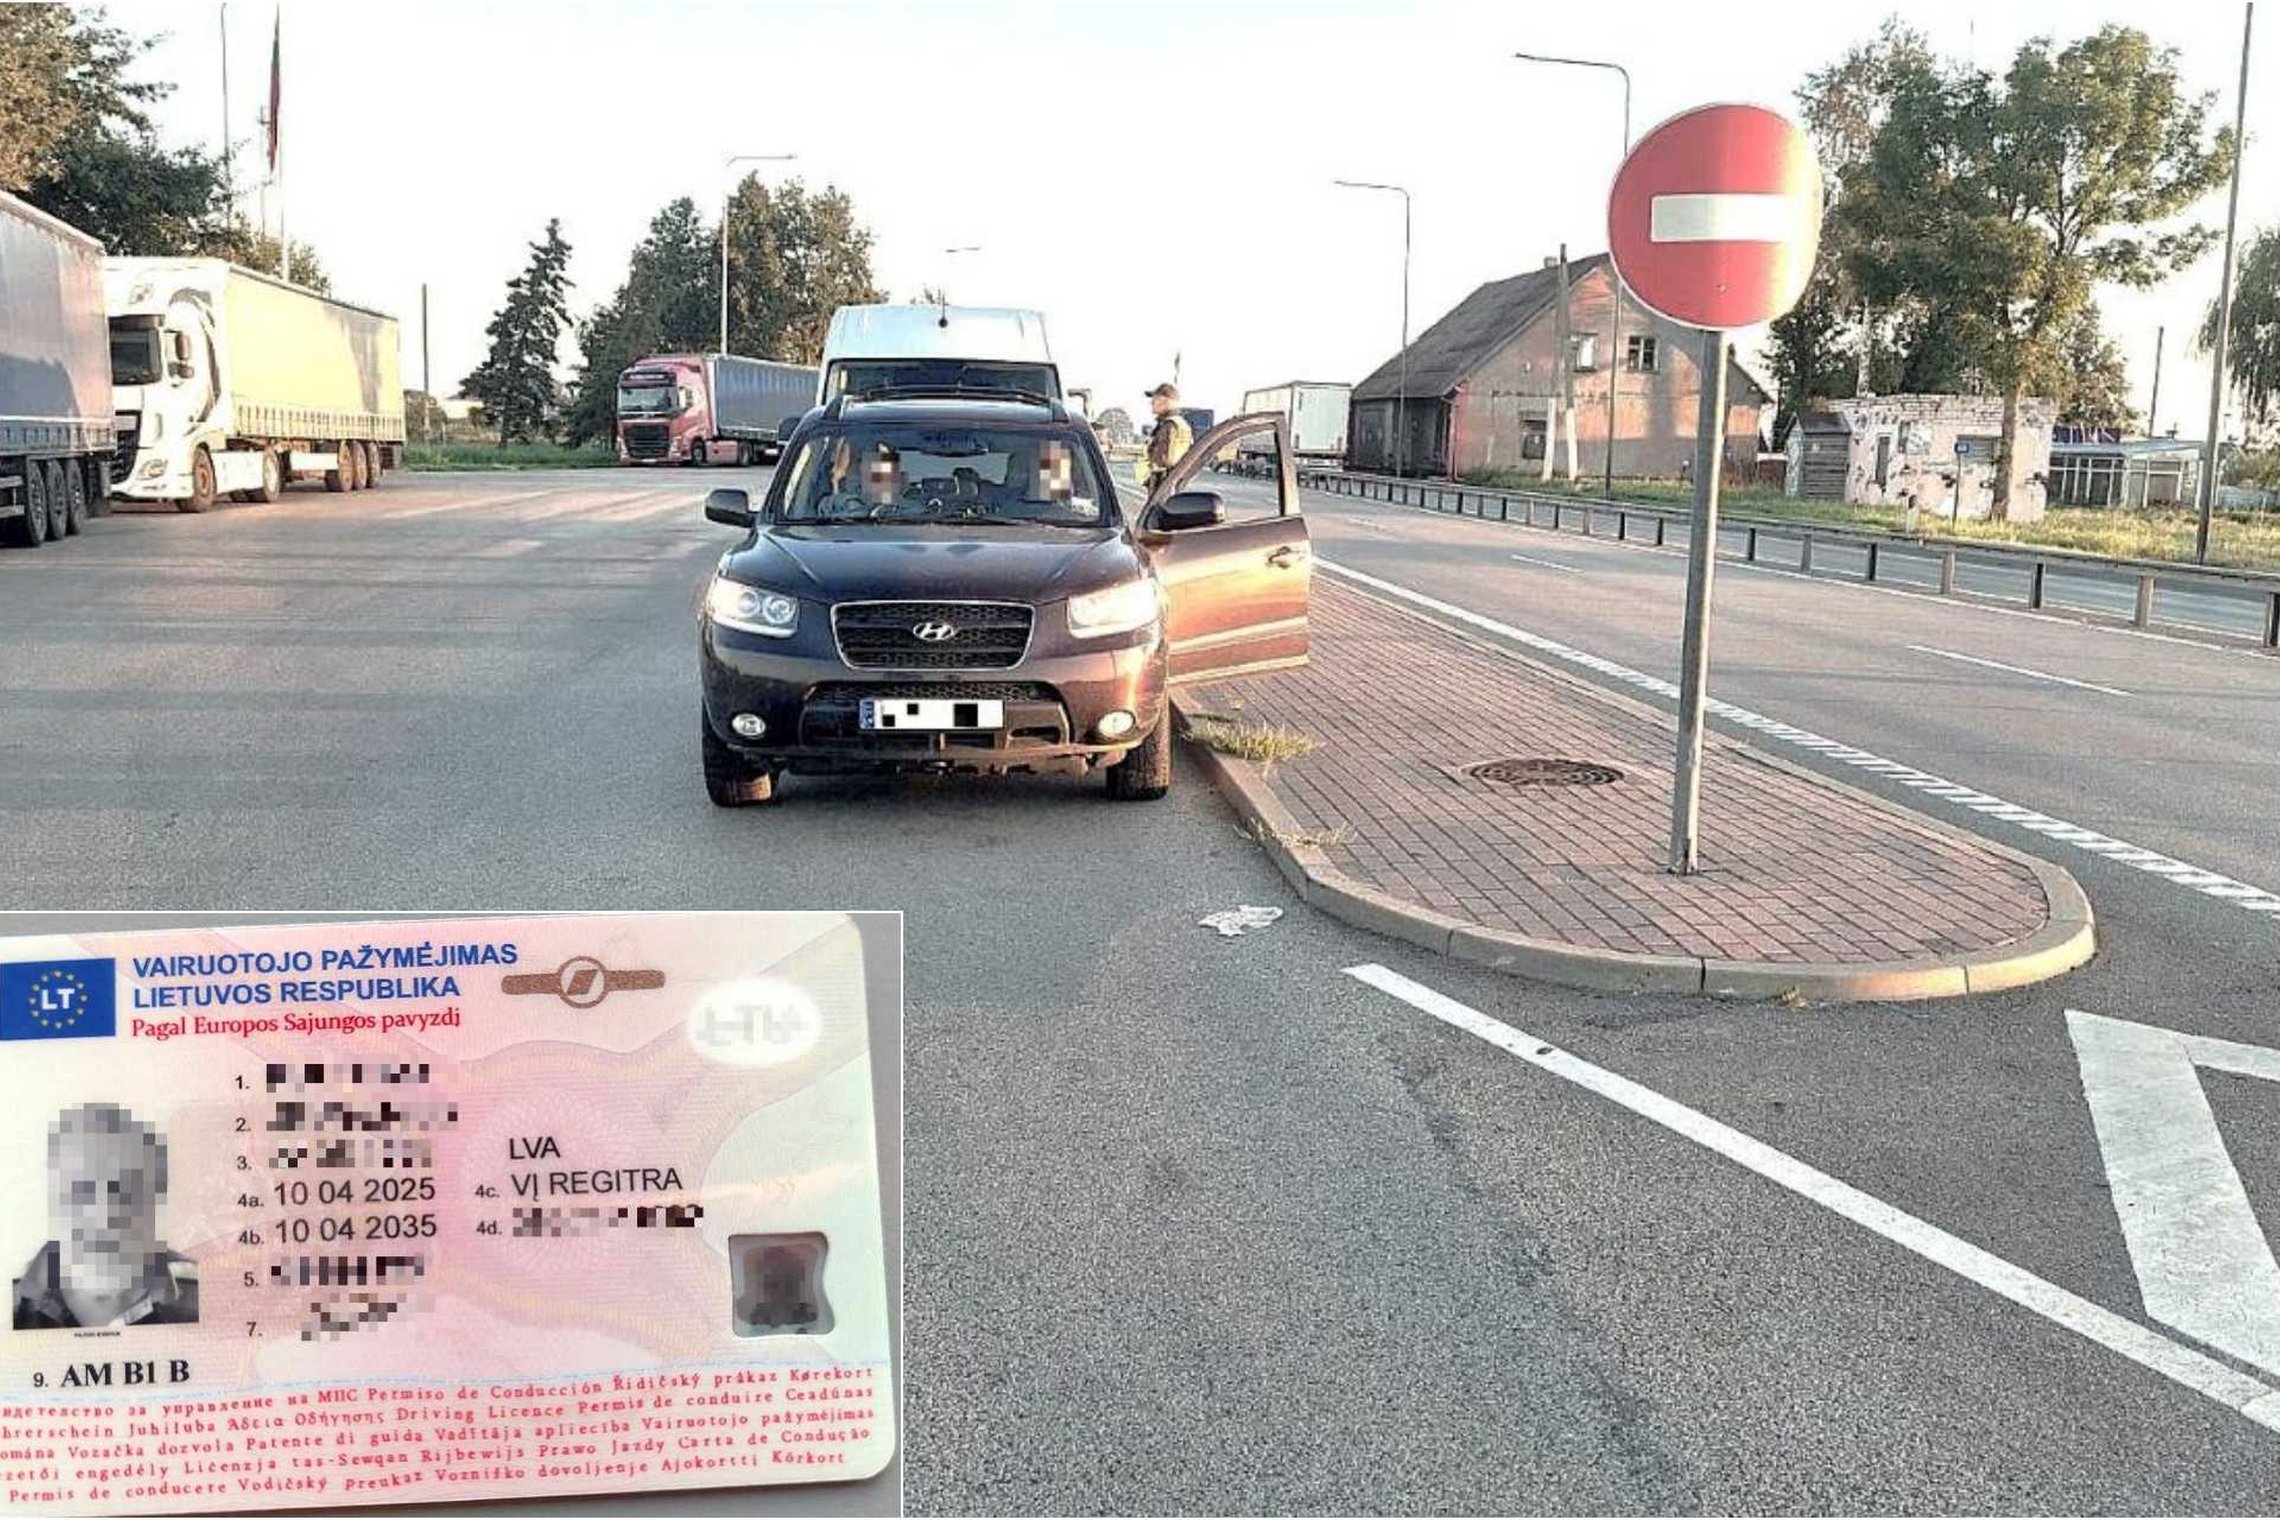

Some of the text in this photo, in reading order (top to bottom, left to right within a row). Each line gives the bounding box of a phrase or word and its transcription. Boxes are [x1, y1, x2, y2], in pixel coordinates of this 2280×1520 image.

[132, 941, 518, 978] VAIRUOTOJO PAŽYMĖJIMAS
[41, 988, 75, 1010] LT
[134, 976, 461, 1008] LIETUVOS RESPUBLIKA
[132, 1017, 186, 1041] Pagal
[194, 1016, 279, 1038] Europos
[235, 1075, 250, 1090] 1.
[236, 1117, 251, 1132] 2.
[509, 1136, 561, 1159] LVA
[236, 1156, 252, 1170] 3.
[237, 1177, 436, 1208] 4a. 10 04 2025
[475, 1168, 683, 1202] 4c. VĮ REGITRA
[238, 1214, 437, 1245] 4b. 10 04 2035
[476, 1221, 502, 1235] 4d.
[244, 1272, 258, 1287] 5.
[247, 1322, 262, 1337] 7.
[33, 1373, 48, 1387] 9.
[61, 1363, 112, 1387] AM
[170, 1359, 190, 1383] B
[368, 1387, 445, 1400] Permiso
[458, 1386, 479, 1400] de
[490, 1381, 602, 1399] Conducción
[129, 1420, 215, 1437] Juhiluba
[397, 1406, 475, 1424] Driving
[488, 1405, 565, 1419] Licence
[578, 1398, 644, 1414] Permis
[654, 1395, 673, 1408] de
[686, 1392, 774, 1407] conduire
[158, 1438, 235, 1456] dozvola
[246, 1435, 323, 1451] Patente
[336, 1432, 355, 1446] di
[370, 1428, 424, 1447] guida
[642, 1413, 749, 1431] Vairuotojo
[293, 1453, 408, 1469] tas-Sewqan
[421, 1447, 525, 1466] Rijbewijs
[538, 1443, 597, 1458] Prawo
[612, 1438, 665, 1455] Jazdy
[678, 1435, 734, 1450] Carta
[748, 1432, 769, 1446] de
[9, 1488, 75, 1503] Permis
[89, 1486, 111, 1500] de
[126, 1481, 227, 1498] conducere
[538, 1461, 649, 1477] dovoljenje
[661, 1454, 758, 1474] Ajokortti
